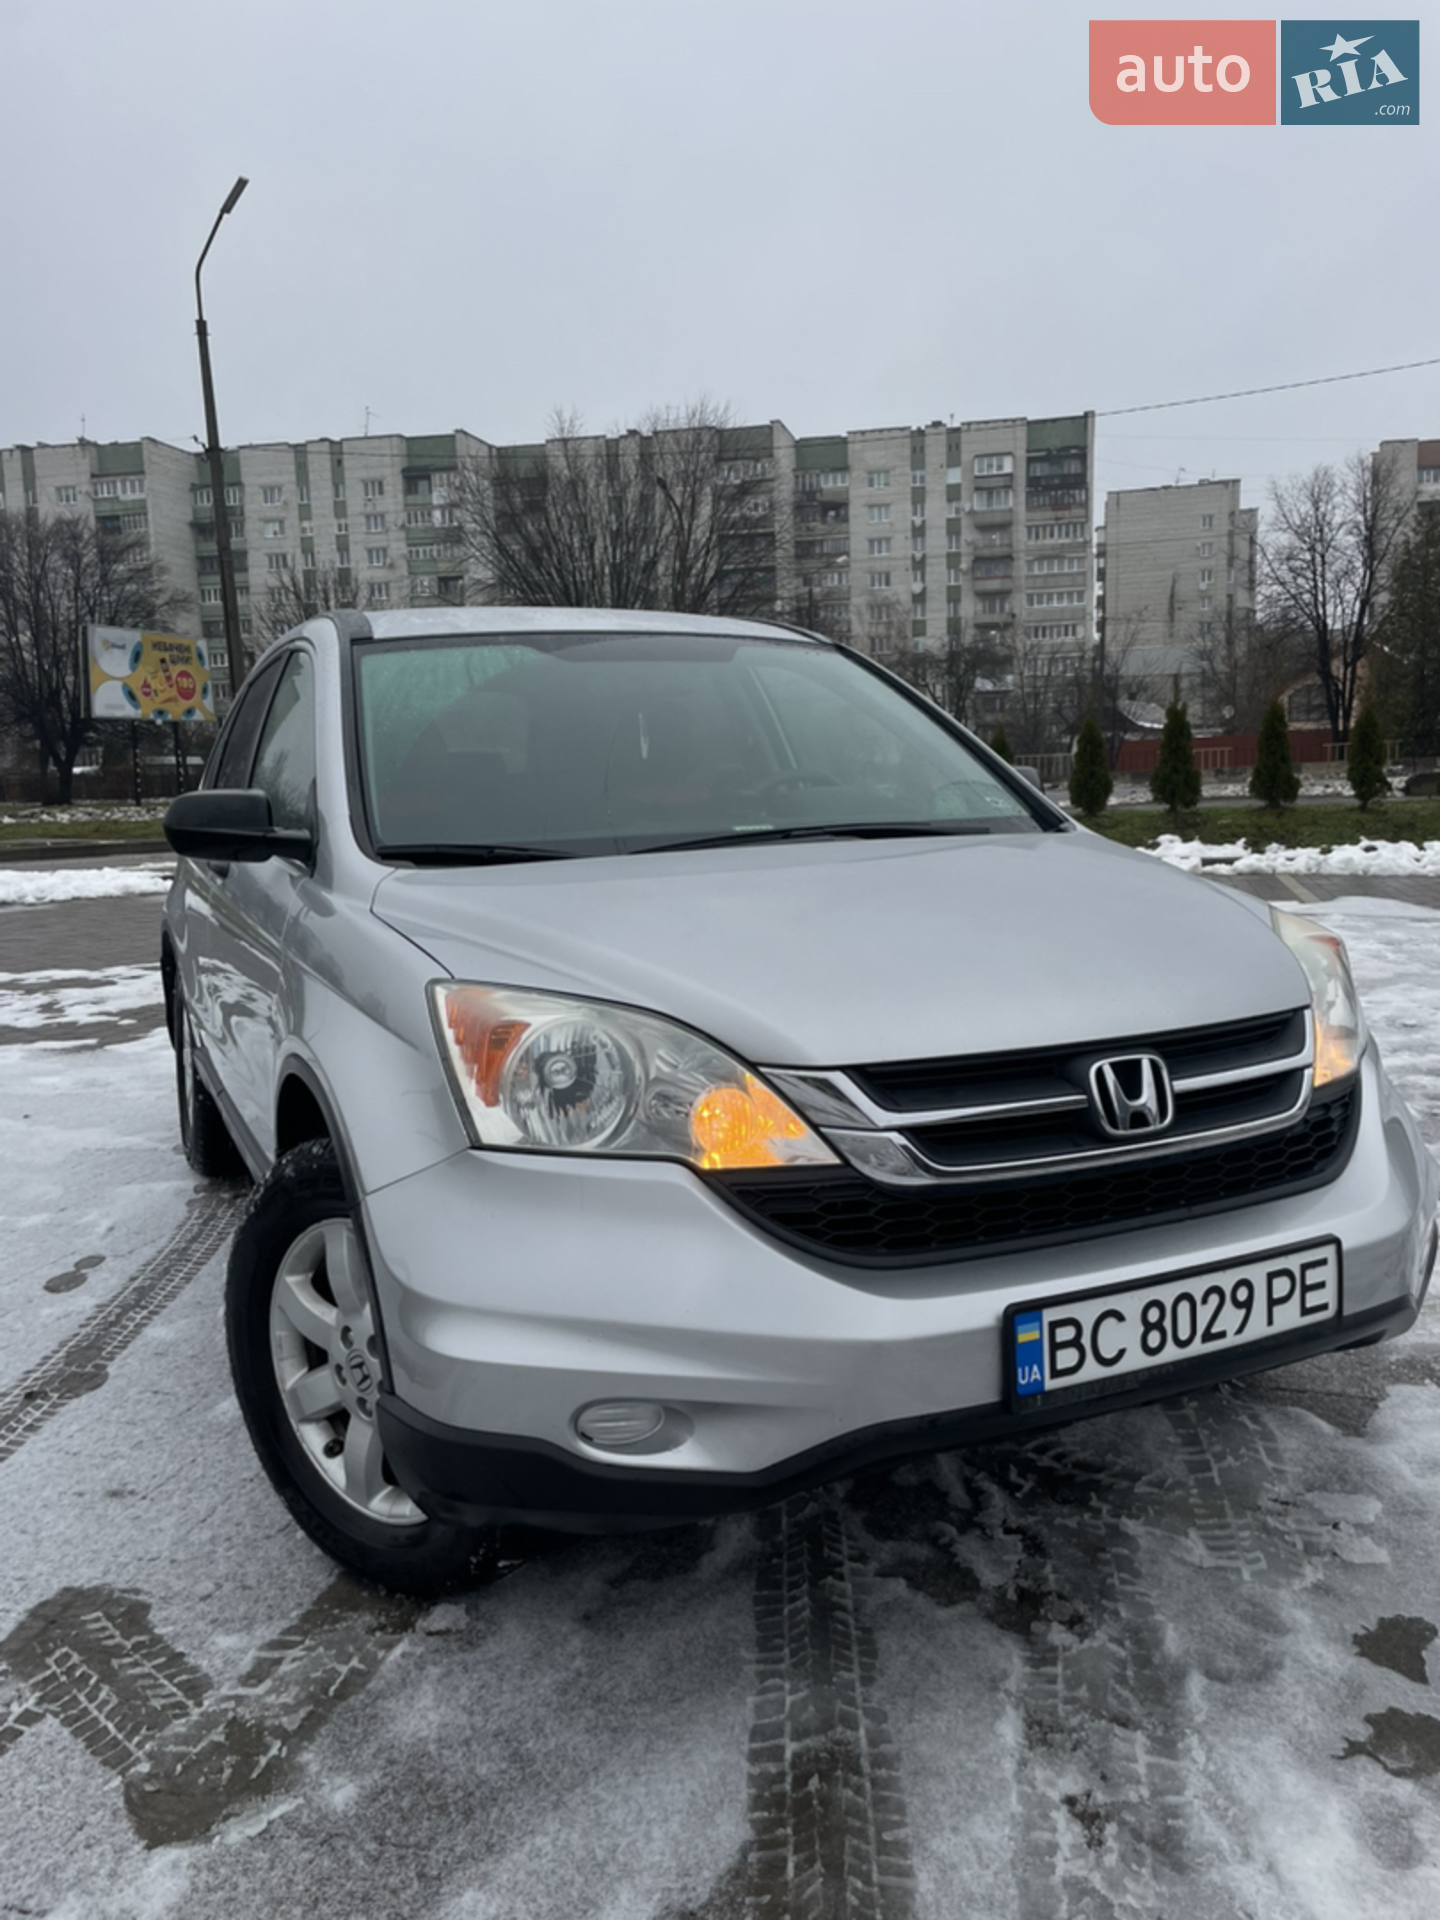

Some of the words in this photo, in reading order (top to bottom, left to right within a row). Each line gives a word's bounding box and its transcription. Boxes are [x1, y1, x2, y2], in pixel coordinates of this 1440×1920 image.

[1048, 1309, 1128, 1380] BC
[1140, 1278, 1255, 1357] 8029
[1266, 1257, 1330, 1327] PE
[1018, 1365, 1042, 1385] UA
